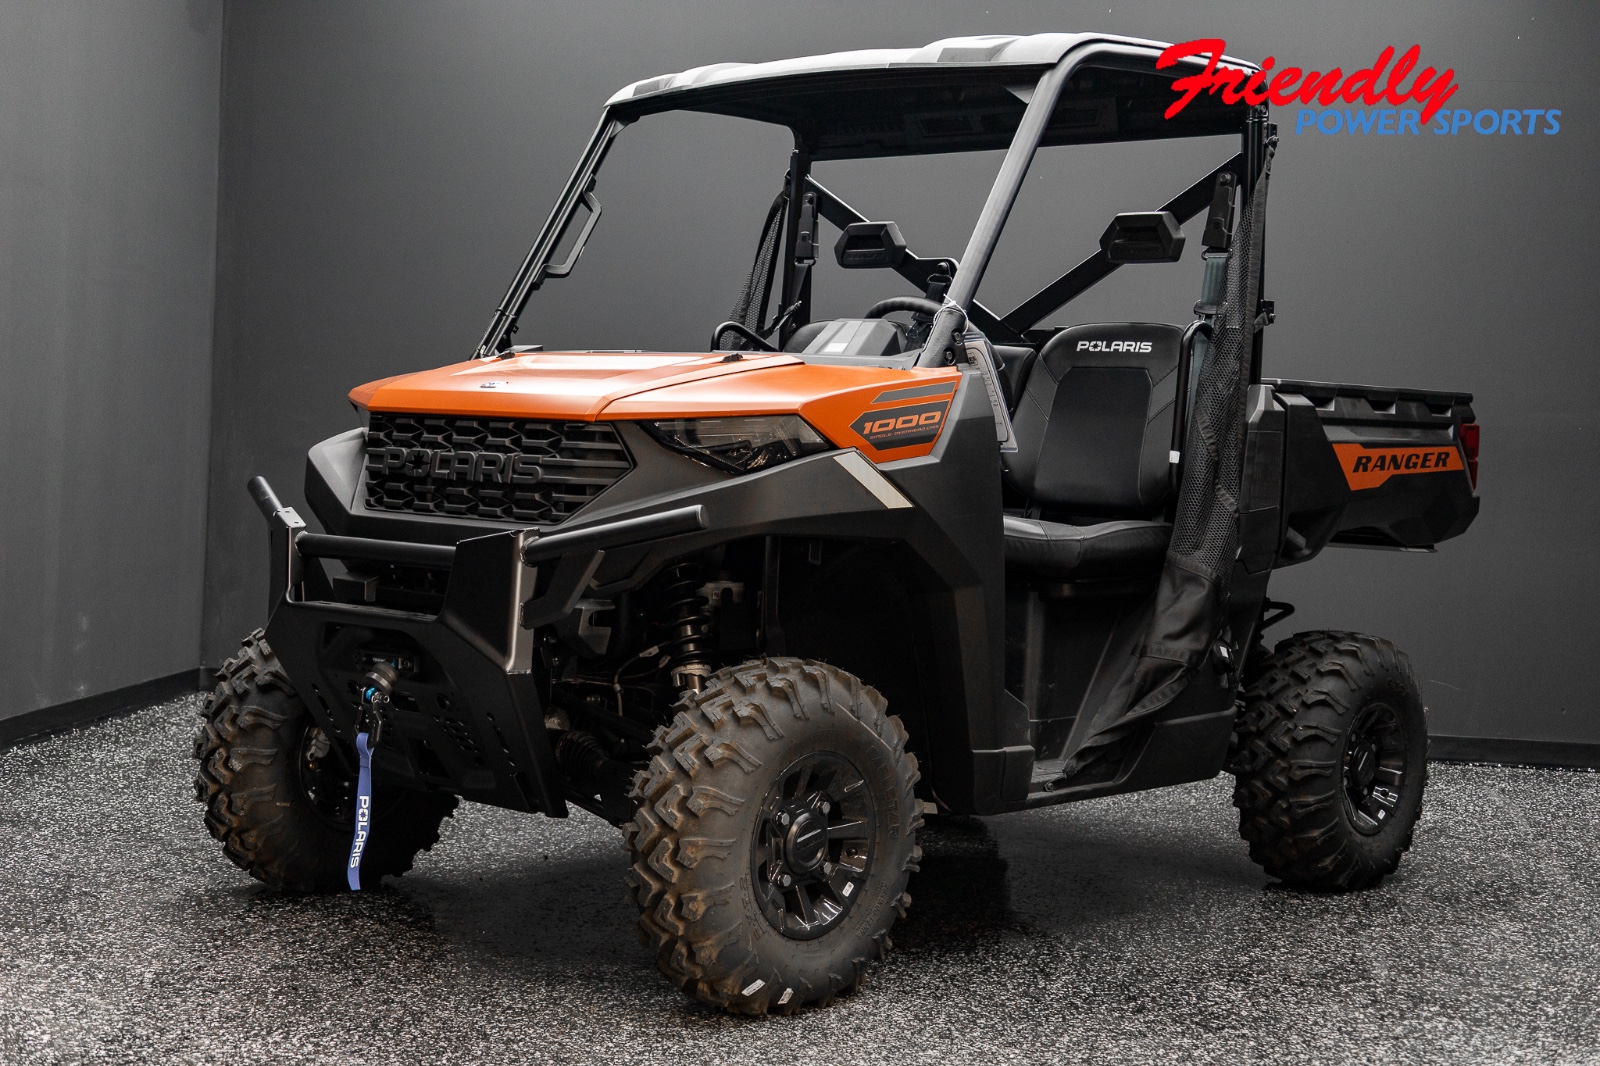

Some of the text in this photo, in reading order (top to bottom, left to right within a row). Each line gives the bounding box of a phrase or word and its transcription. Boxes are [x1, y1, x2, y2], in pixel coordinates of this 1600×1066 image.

[1076, 340, 1153, 353] POLARIS
[863, 411, 942, 435] 1000
[382, 446, 544, 485] POLARIS
[1352, 451, 1450, 473] RANGER
[350, 795, 370, 869] POLARIS
